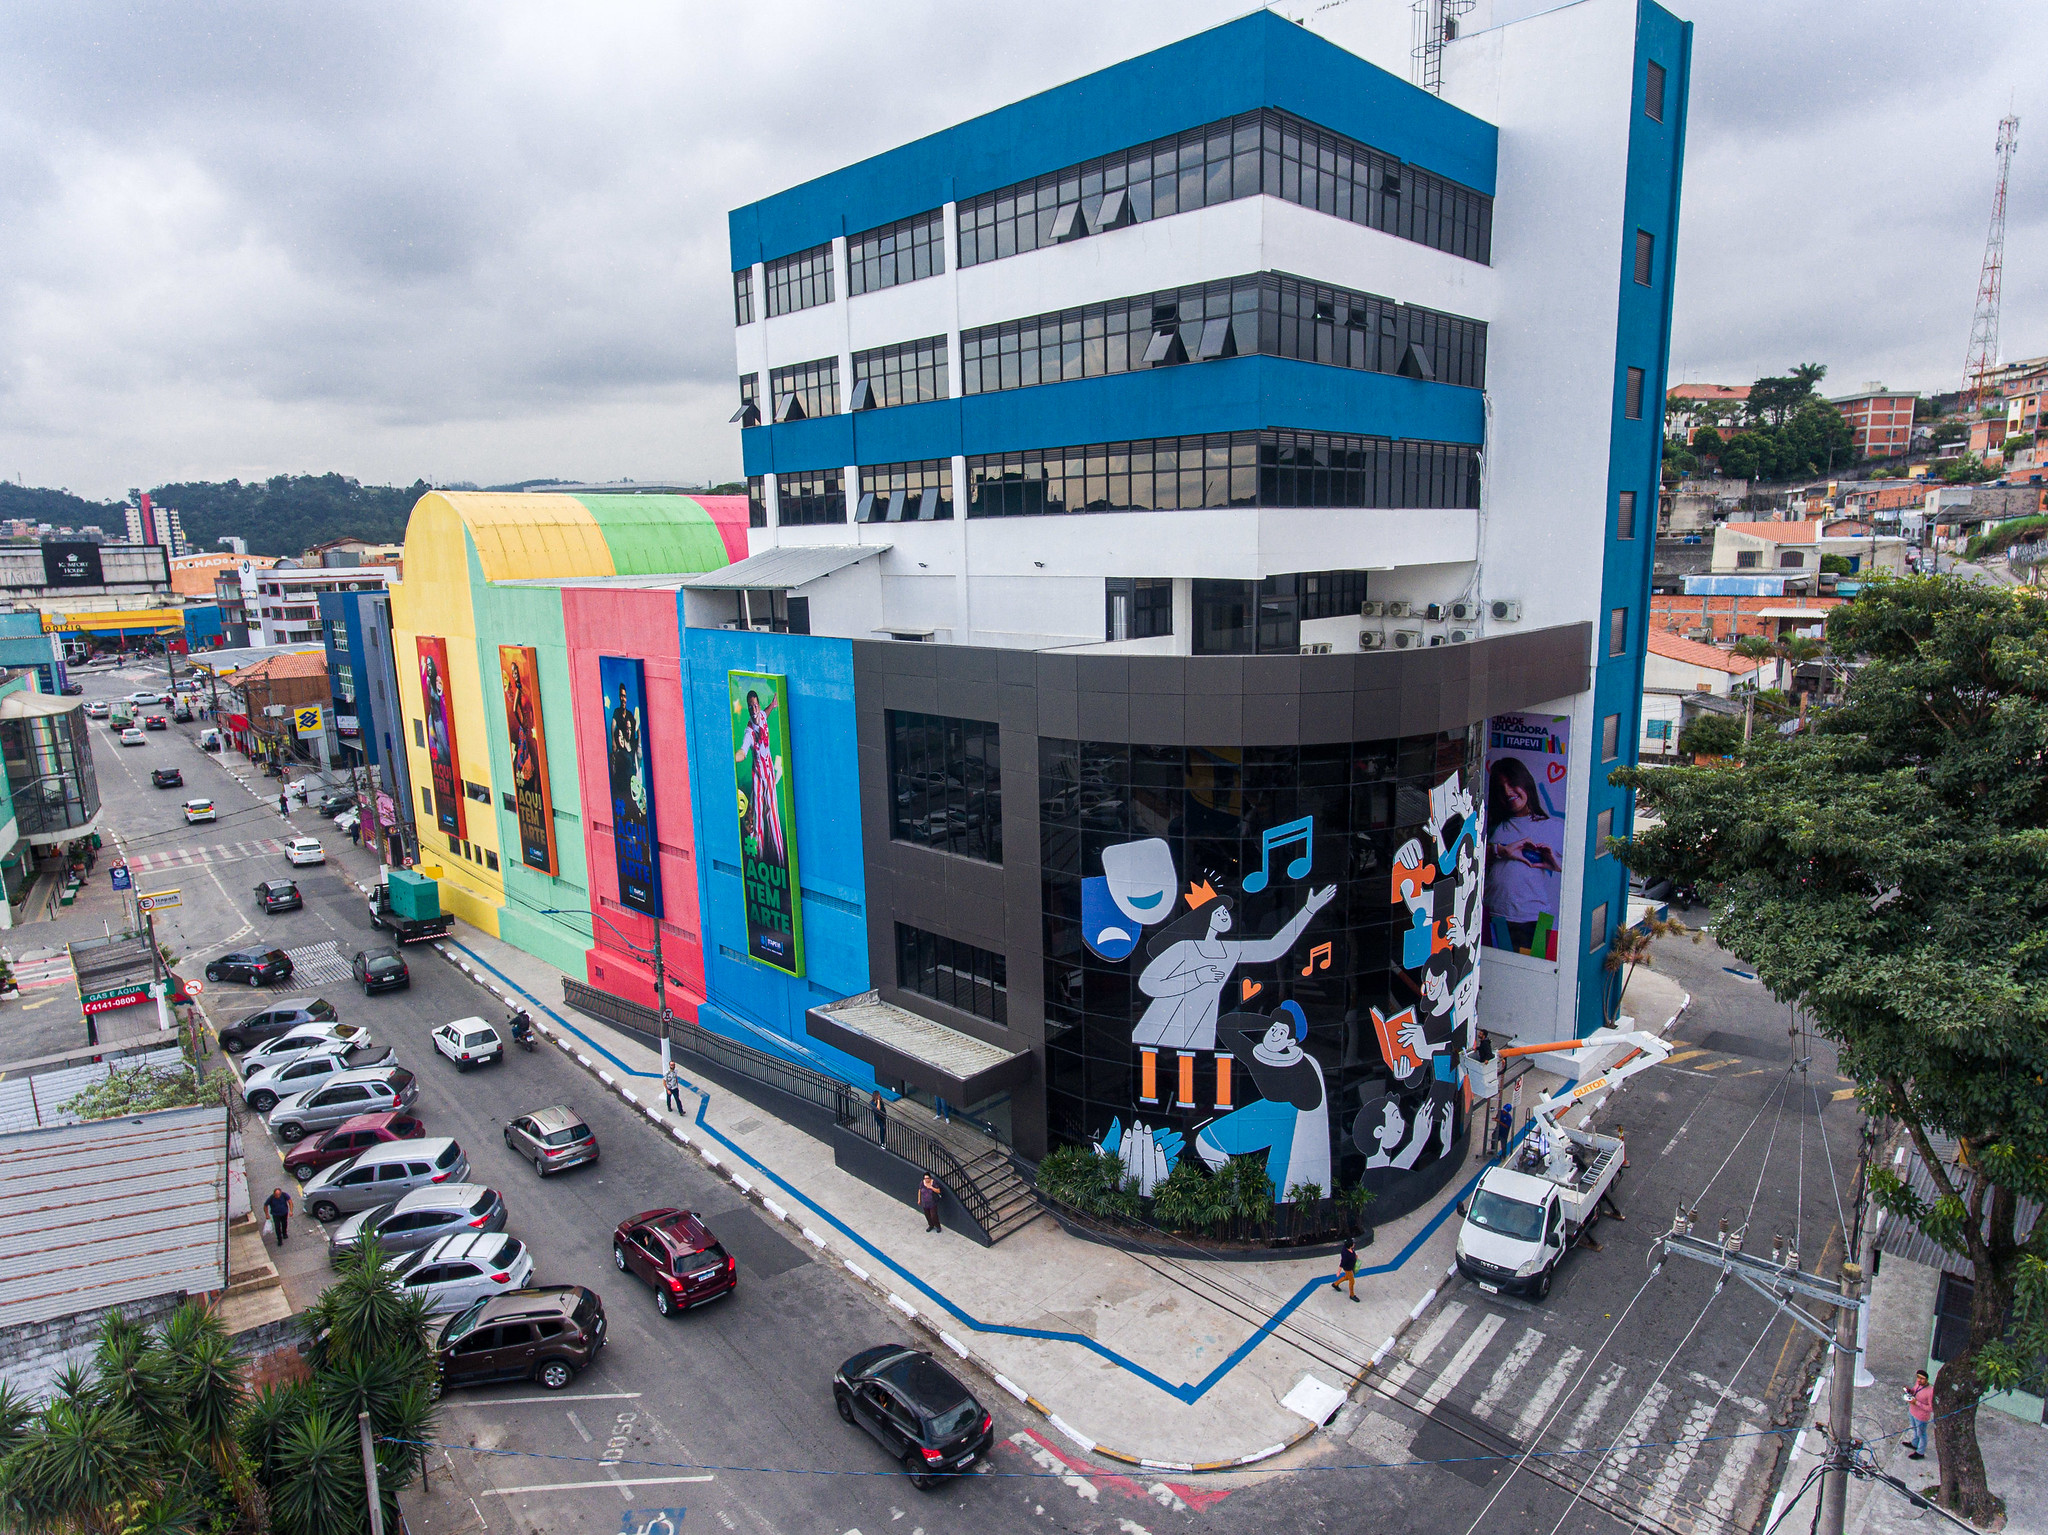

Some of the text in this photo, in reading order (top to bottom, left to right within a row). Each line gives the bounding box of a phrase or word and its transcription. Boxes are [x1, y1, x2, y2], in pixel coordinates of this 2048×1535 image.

[1506, 736, 1539, 748] ITAPEVI
[433, 762, 452, 781] AQUI
[434, 777, 450, 795] TEM
[518, 788, 542, 810] AQUI
[519, 806, 540, 826] TEM
[522, 823, 546, 845] ARTE
[617, 818, 647, 844] AQUI
[617, 837, 643, 862] TEM
[744, 835, 758, 857] #
[621, 857, 650, 884] ARTE
[746, 858, 787, 889] AQUI
[746, 879, 781, 910] TEM
[750, 902, 791, 935] ARTE
[91, 996, 136, 1011] 4141-0800
[598, 1412, 638, 1466] IDOSO
